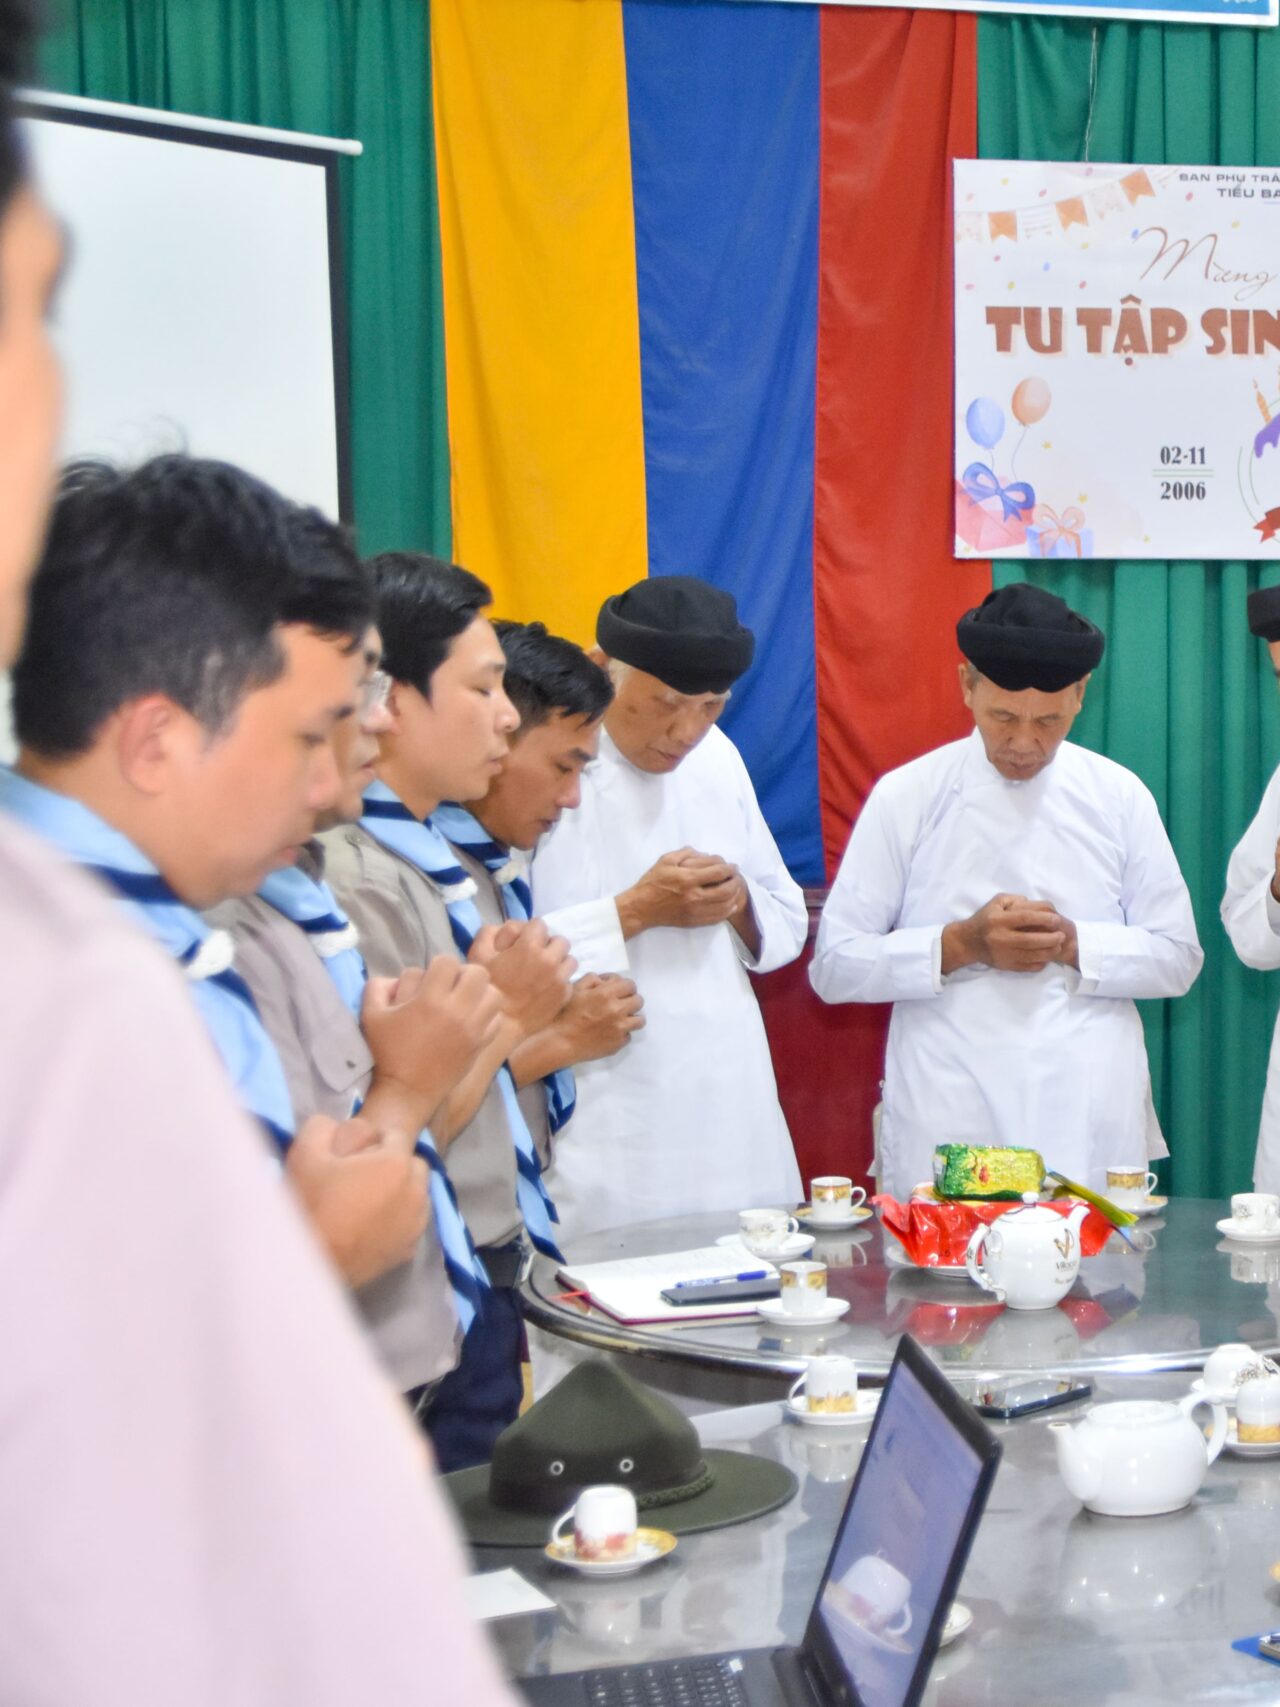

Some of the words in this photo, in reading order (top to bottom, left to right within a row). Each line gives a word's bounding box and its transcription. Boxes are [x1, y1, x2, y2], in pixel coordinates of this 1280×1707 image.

[1179, 173, 1211, 182] BAN
[1132, 227, 1278, 302] Mừng
[985, 306, 1063, 354] TU
[1076, 293, 1188, 367] TẬP
[1160, 446, 1206, 465] 02-11
[1160, 482, 1206, 501] 2006
